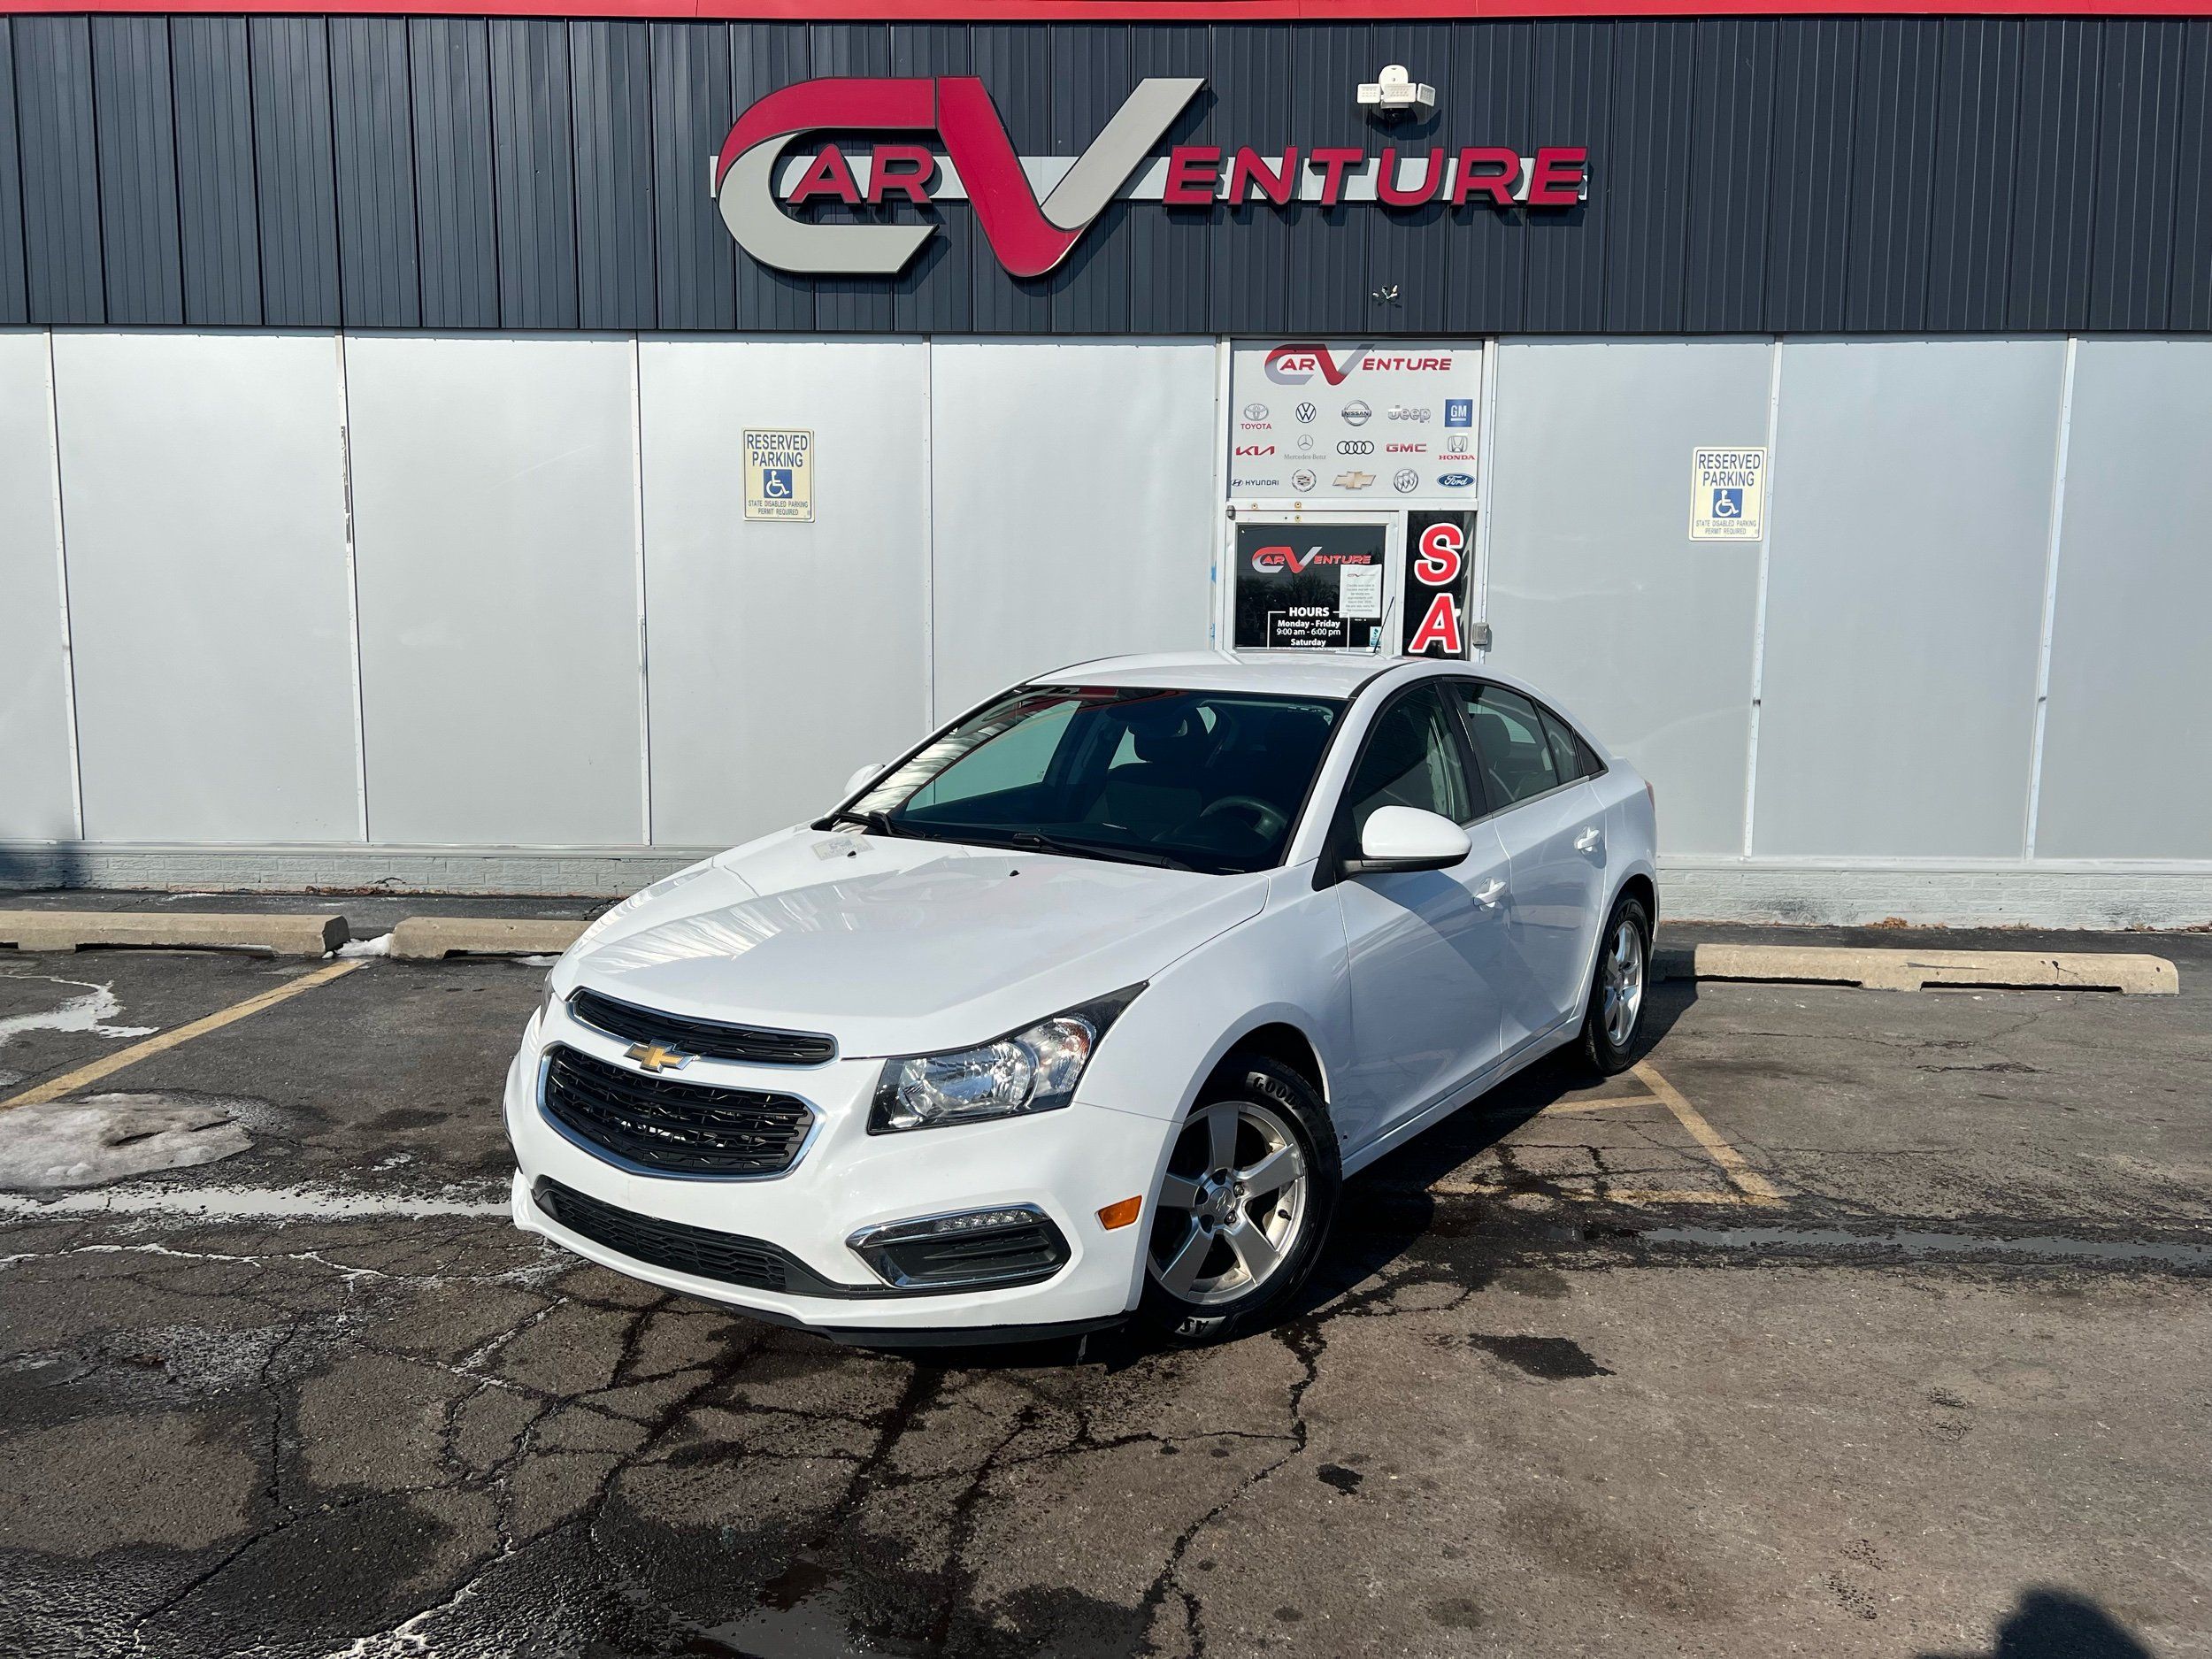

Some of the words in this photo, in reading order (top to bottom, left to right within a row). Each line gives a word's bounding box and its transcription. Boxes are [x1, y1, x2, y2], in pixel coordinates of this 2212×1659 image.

[1387, 405, 1432, 424] Jeep
[1450, 404, 1467, 418] GM
[747, 434, 808, 450] RESERVED
[1386, 443, 1427, 453] GMC
[1235, 445, 1275, 456] KIA
[752, 451, 803, 467] PARKING
[1698, 454, 1761, 469] RESERVED
[1444, 475, 1468, 486] Ford
[1702, 471, 1755, 487] PARKING
[1288, 607, 1330, 617] HOURS
[1277, 619, 1310, 629] Monday
[1315, 619, 1340, 629] Friday
[1290, 638, 1326, 647] Saturday
